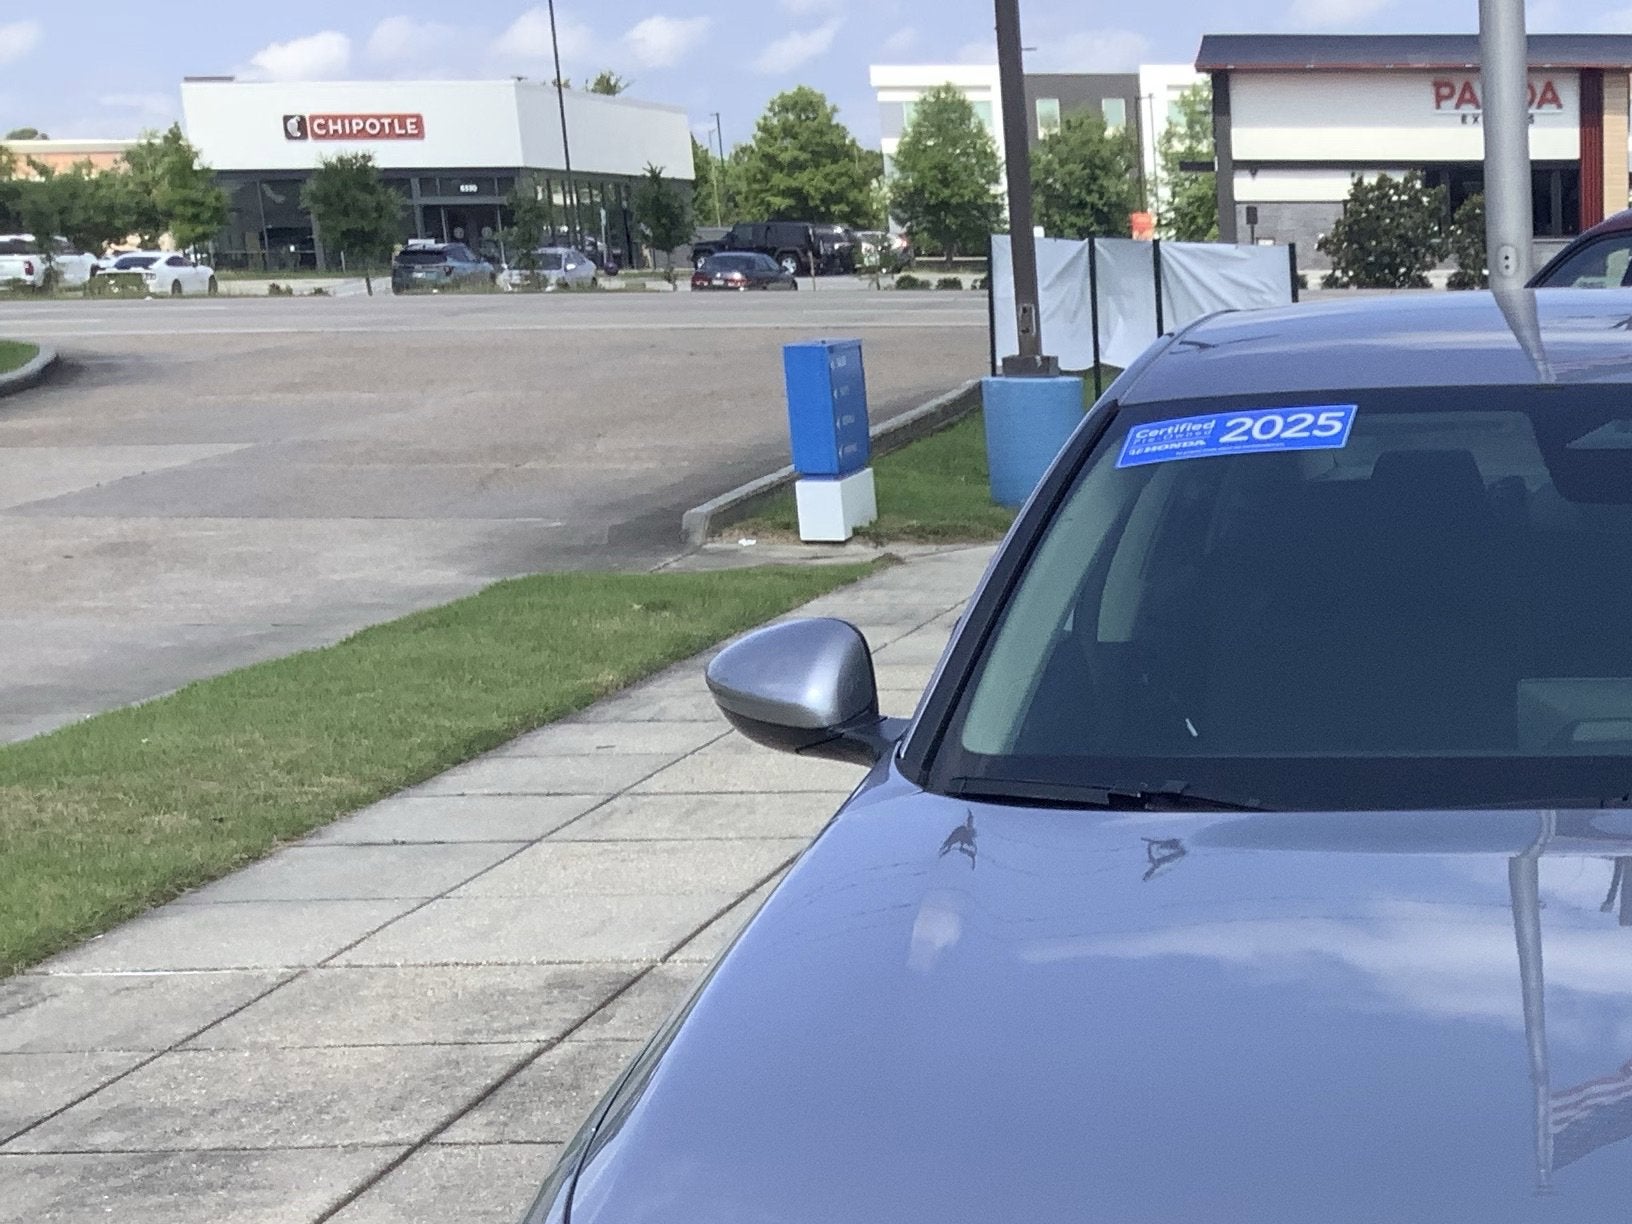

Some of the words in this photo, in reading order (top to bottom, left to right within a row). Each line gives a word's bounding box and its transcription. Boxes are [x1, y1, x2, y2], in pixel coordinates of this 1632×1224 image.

[1432, 80, 1563, 110] PAA
[313, 118, 419, 135] CHIPOTLE
[1135, 419, 1216, 439] Certified
[1219, 411, 1345, 442] 2025
